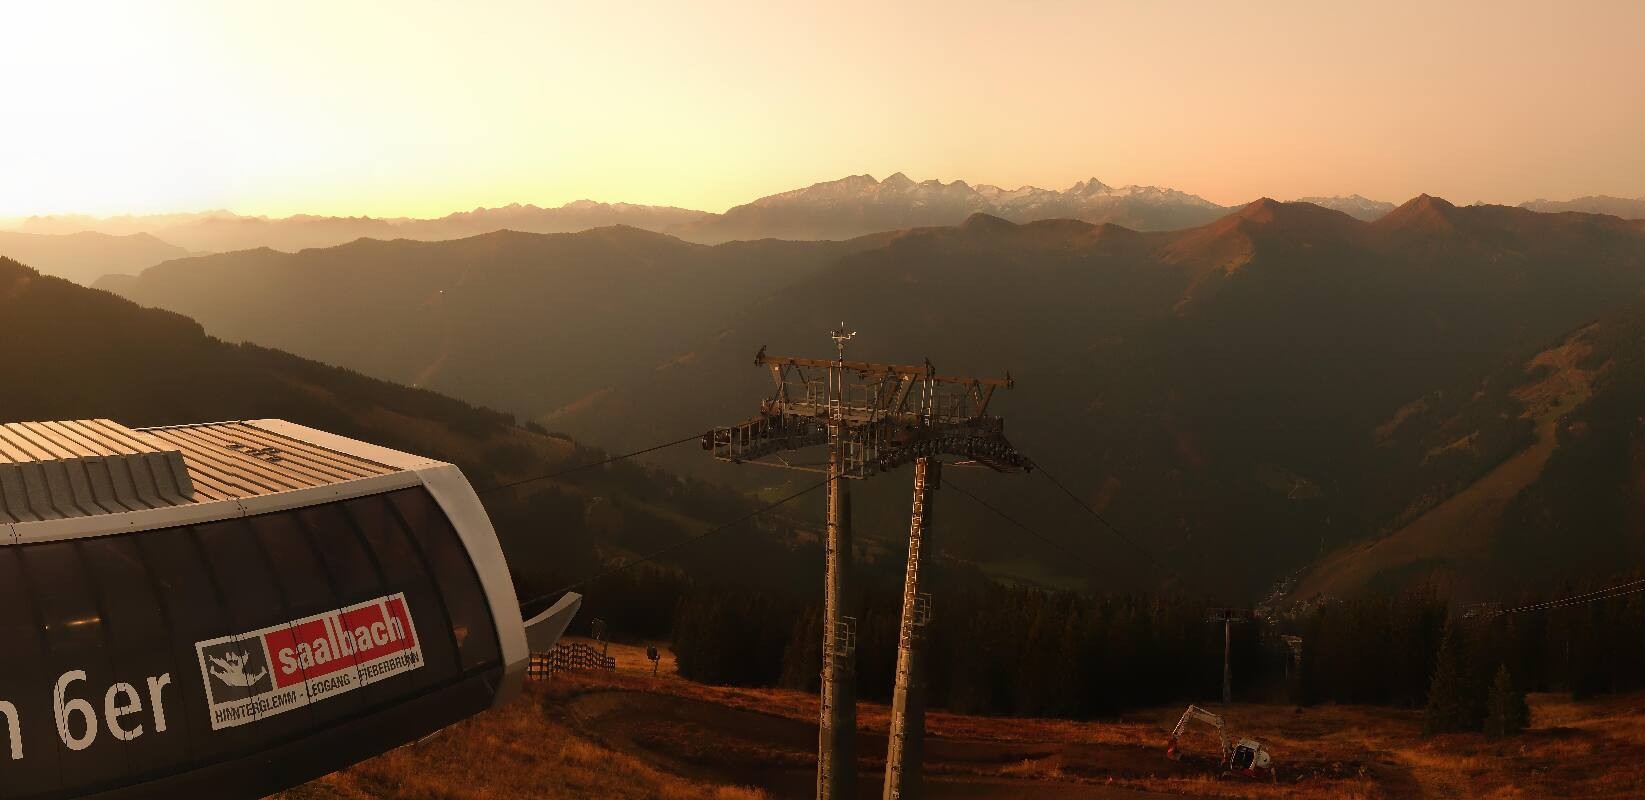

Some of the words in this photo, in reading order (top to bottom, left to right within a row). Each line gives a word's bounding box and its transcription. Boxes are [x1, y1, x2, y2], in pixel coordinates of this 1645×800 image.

[278, 599, 405, 675] saalbach
[53, 669, 171, 750] 6er
[307, 673, 351, 698] LEOGANG
